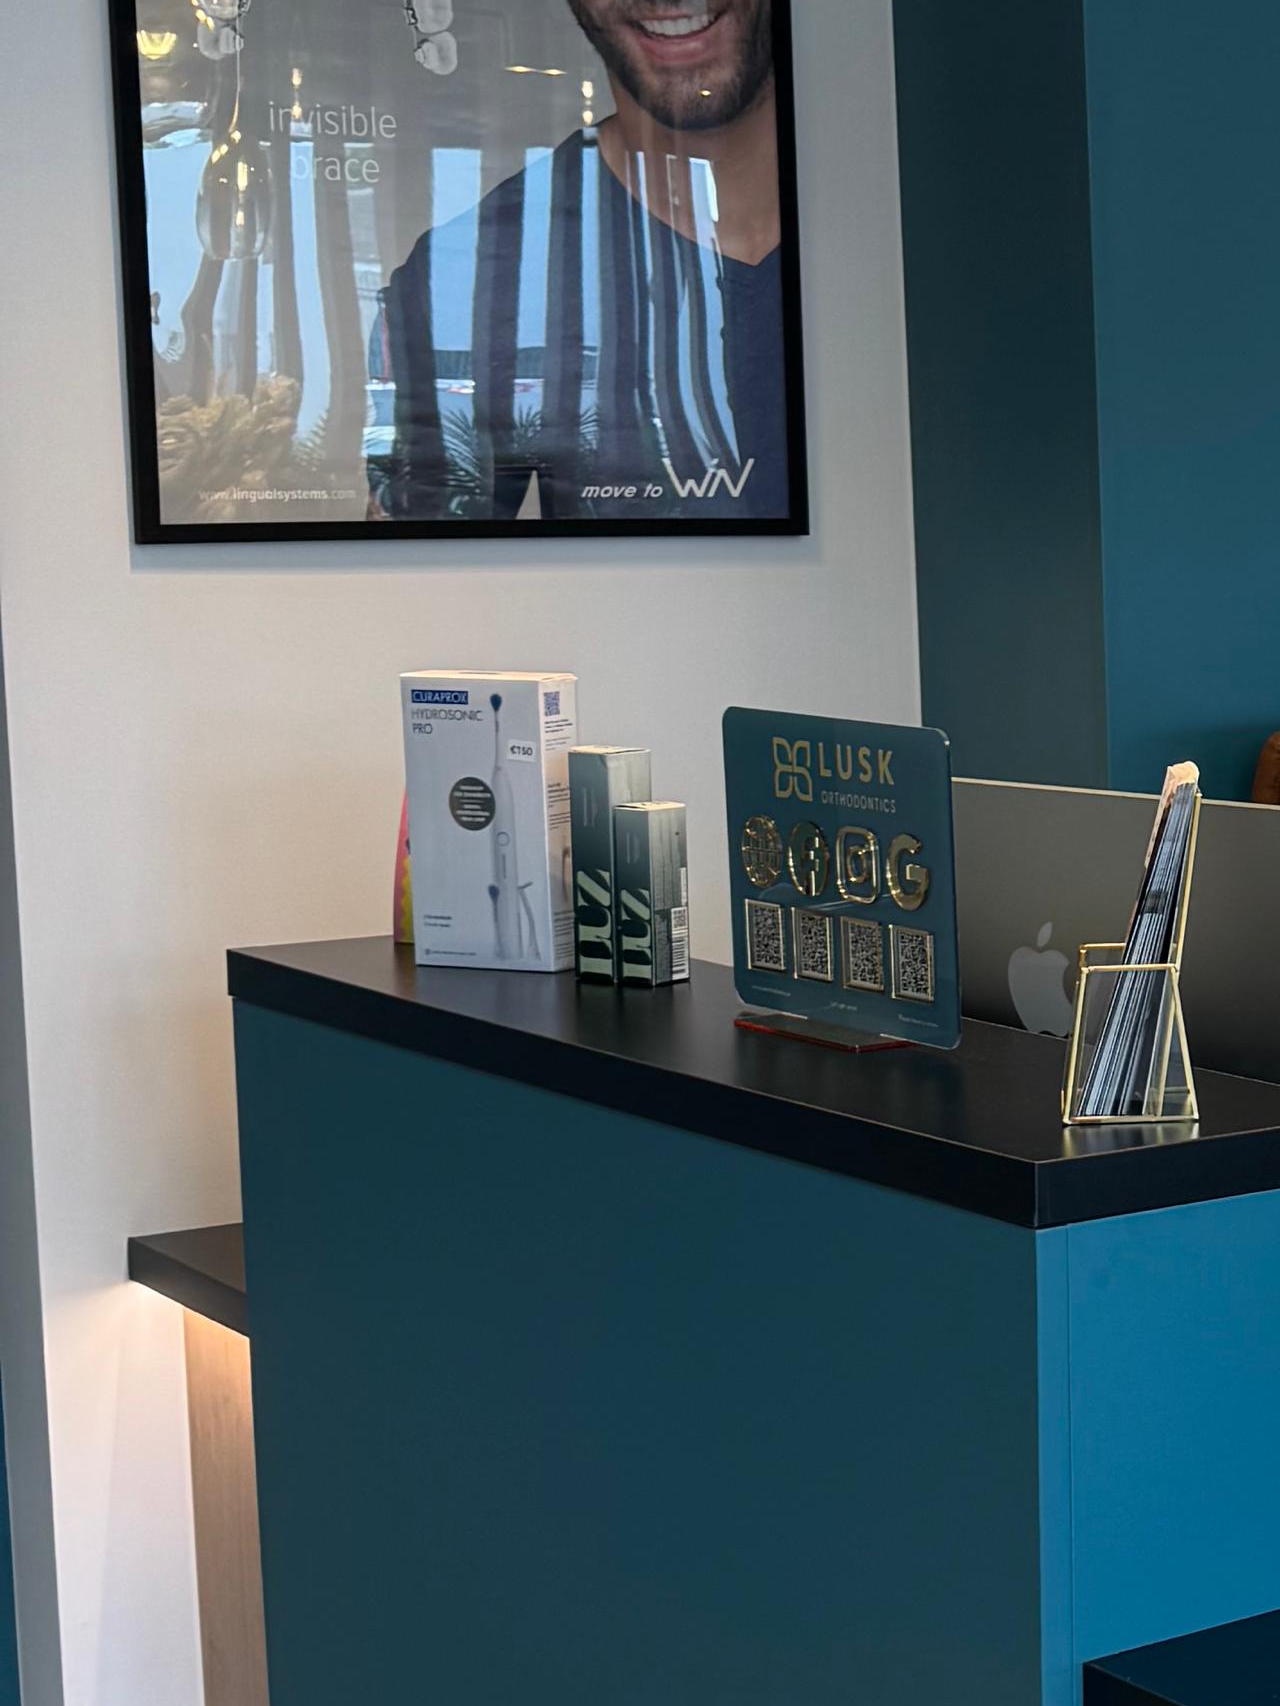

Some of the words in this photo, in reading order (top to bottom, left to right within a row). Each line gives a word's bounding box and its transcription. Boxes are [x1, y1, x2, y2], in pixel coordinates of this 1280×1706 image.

[581, 485, 637, 499] move
[643, 482, 664, 499] to
[412, 691, 468, 703] CURAPROX
[411, 708, 484, 722] HYDROSONIC
[412, 723, 434, 735] PRO
[509, 745, 534, 756] €150
[817, 741, 895, 786] LUSK
[820, 790, 897, 814] ORTHODONTICS
